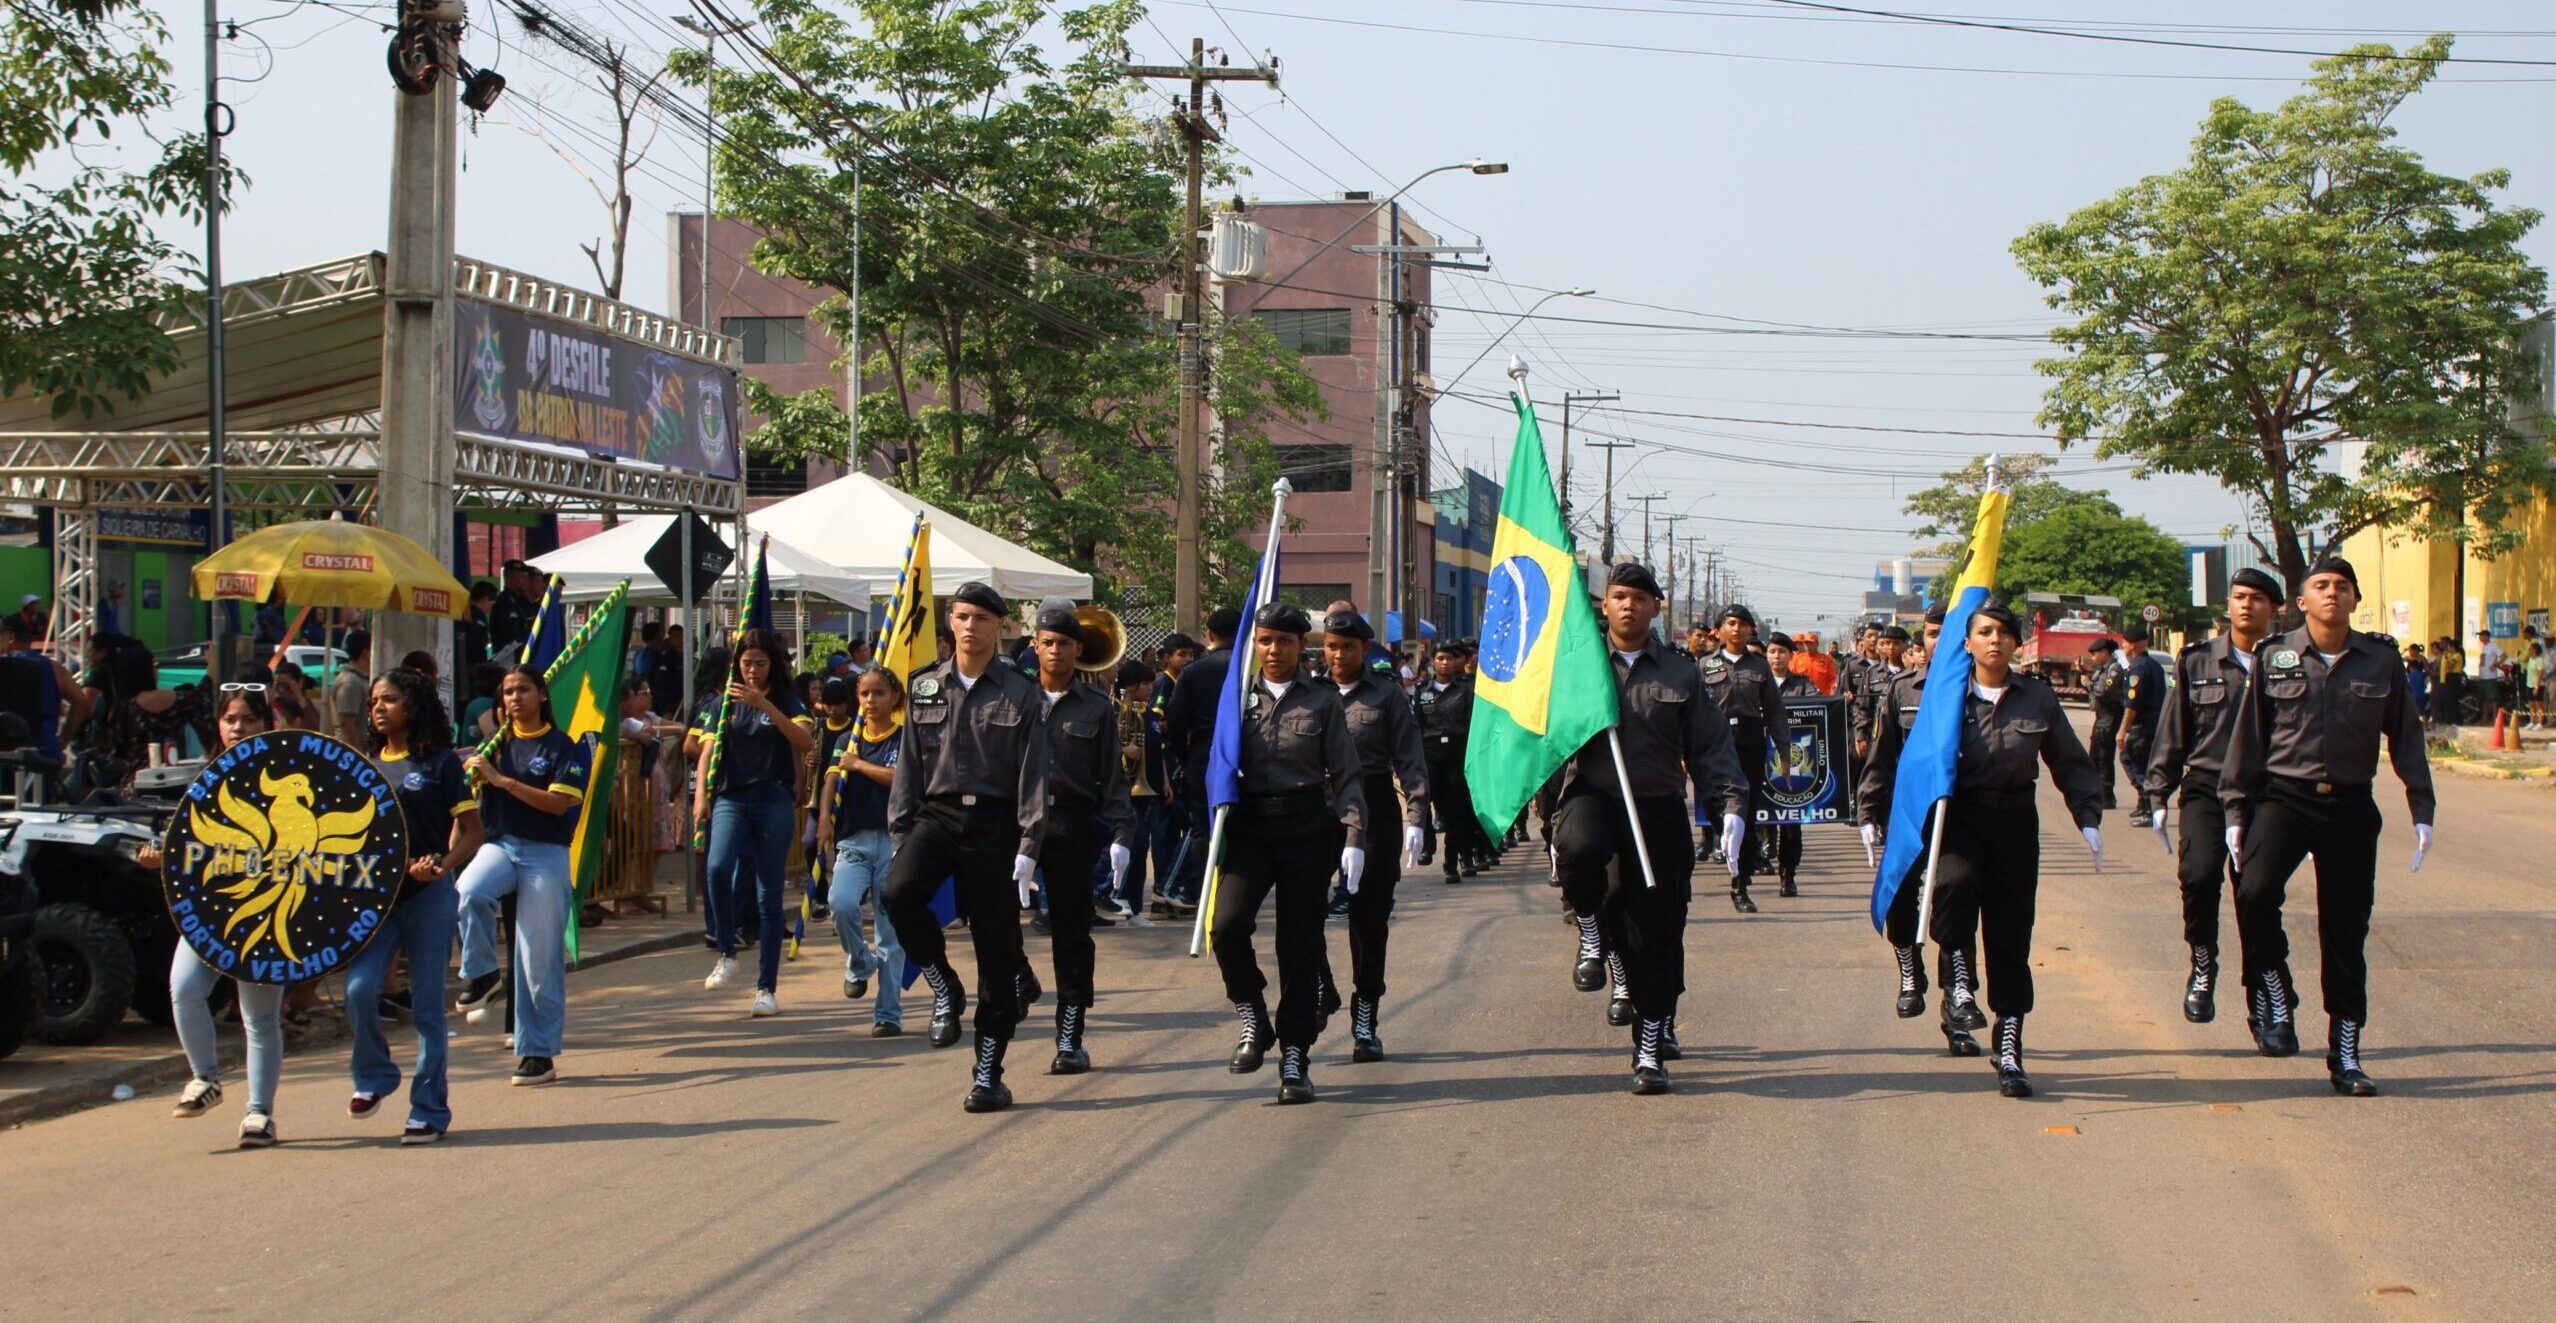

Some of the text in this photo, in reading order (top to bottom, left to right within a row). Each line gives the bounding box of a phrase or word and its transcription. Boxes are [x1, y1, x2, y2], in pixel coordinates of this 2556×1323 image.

[526, 328, 611, 398] 4º DESFILE
[517, 388, 533, 434] DA
[578, 400, 593, 443] NA
[595, 404, 629, 451] LESTE
[147, 520, 161, 538] DE
[303, 554, 372, 572] CRYSTAL
[215, 574, 256, 596] CRYSTAL
[414, 590, 450, 612] CRYSTAL
[2145, 608, 2158, 617] 40
[1793, 709, 1824, 718] MILITAR
[1818, 739, 1826, 767] UNIÃO
[187, 735, 396, 818] BANDA MUSICAL
[1773, 791, 1814, 804] EDUCAÇÃO
[1775, 807, 1838, 820] VELHO
[181, 841, 382, 891] PHOENIX
[172, 897, 238, 972] PORTO
